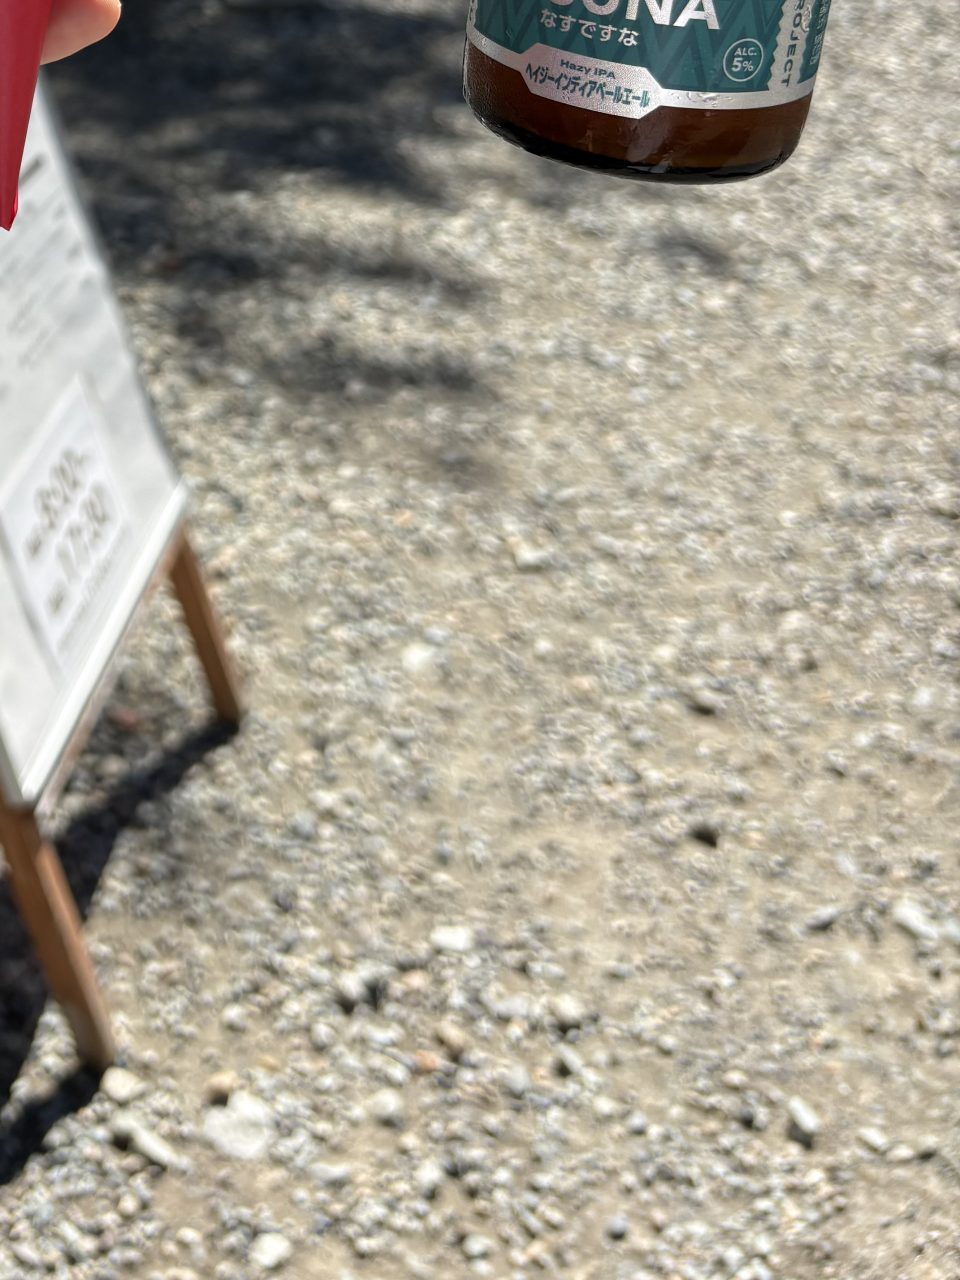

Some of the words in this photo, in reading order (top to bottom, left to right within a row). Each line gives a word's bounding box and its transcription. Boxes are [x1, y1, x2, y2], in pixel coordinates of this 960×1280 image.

[541, 8, 641, 47] なすですな
[734, 47, 757, 56] ALC.
[560, 59, 592, 76] Hazy
[593, 70, 616, 80] IPA
[731, 57, 754, 72] 5%
